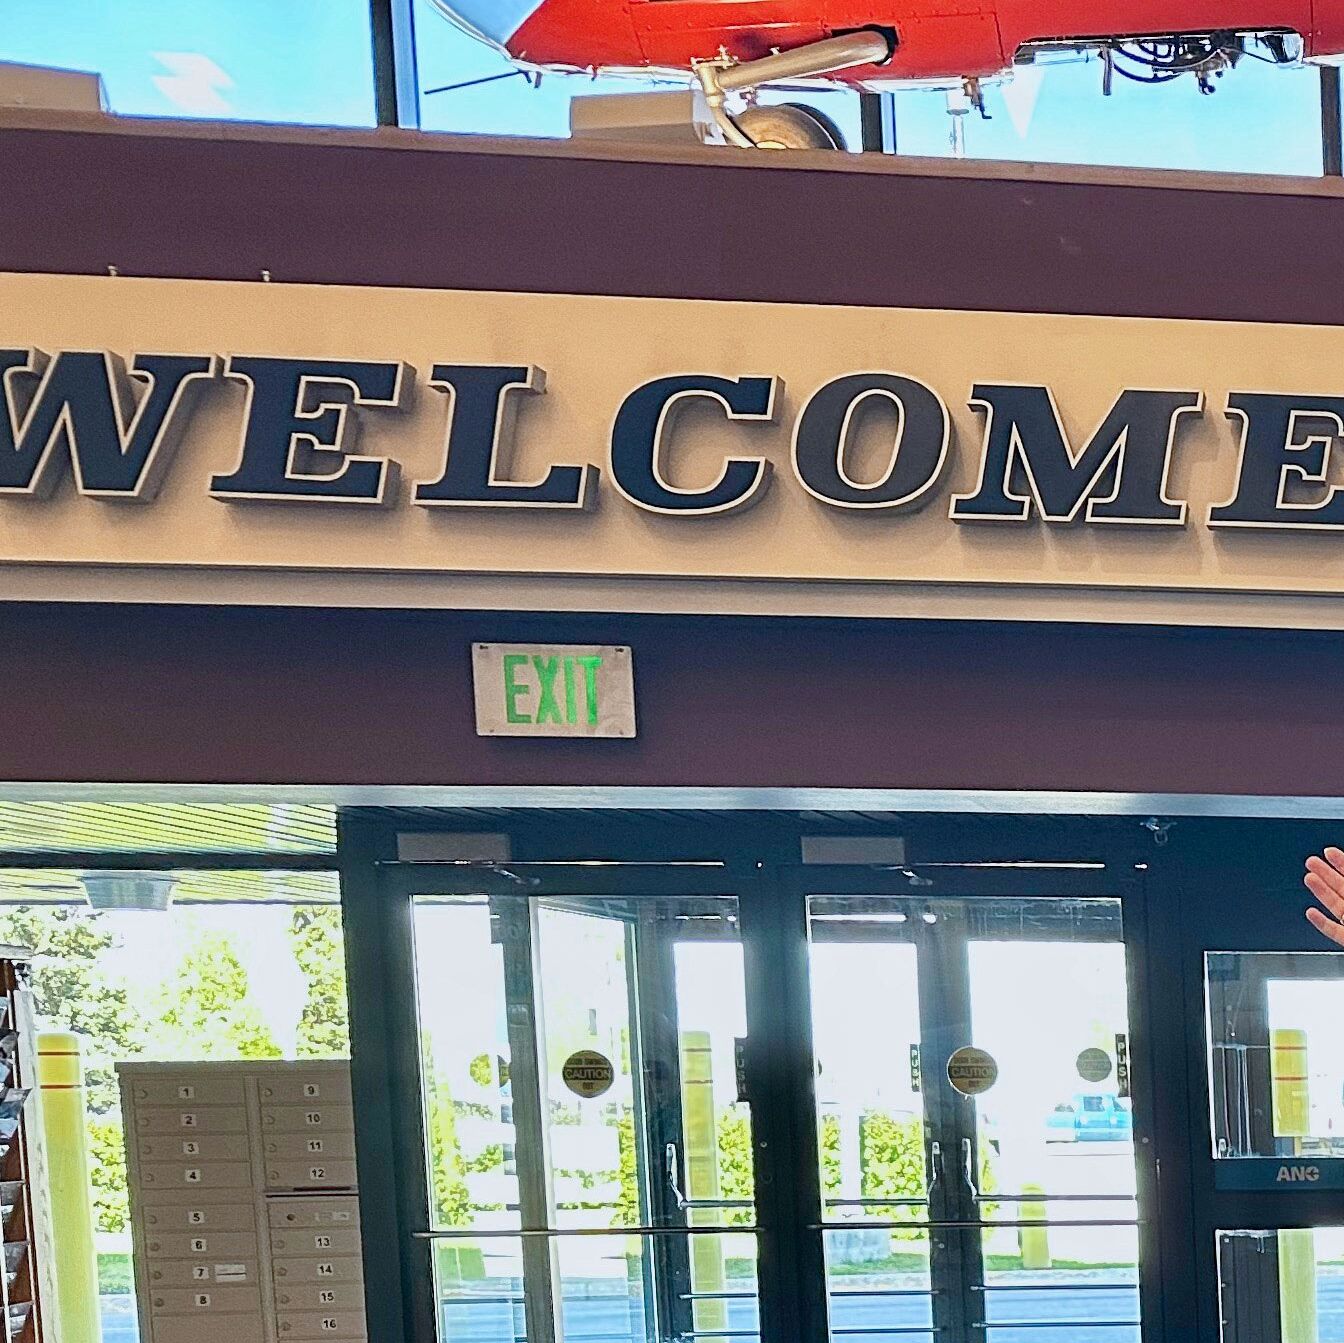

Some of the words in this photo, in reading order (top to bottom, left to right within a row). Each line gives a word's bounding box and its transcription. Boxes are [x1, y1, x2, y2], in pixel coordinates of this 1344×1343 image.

[503, 654, 604, 726] EXIT
[564, 1067, 612, 1080] CAUTION
[950, 1065, 993, 1078] CAUTION
[183, 1087, 189, 1097] 1
[307, 1085, 315, 1095] 9
[185, 1115, 193, 1125] 2
[307, 1113, 321, 1123] 10
[187, 1143, 195, 1153] 3
[309, 1141, 321, 1150] 11
[189, 1171, 197, 1180] 4
[311, 1168, 325, 1178] 12
[1276, 1166, 1320, 1182] ANC
[193, 1212, 201, 1222] 5
[317, 1237, 330, 1247] 13
[197, 1268, 205, 1277] 7
[319, 1265, 332, 1274] 14
[321, 1292, 334, 1302] 15
[323, 1319, 337, 1329] 16
